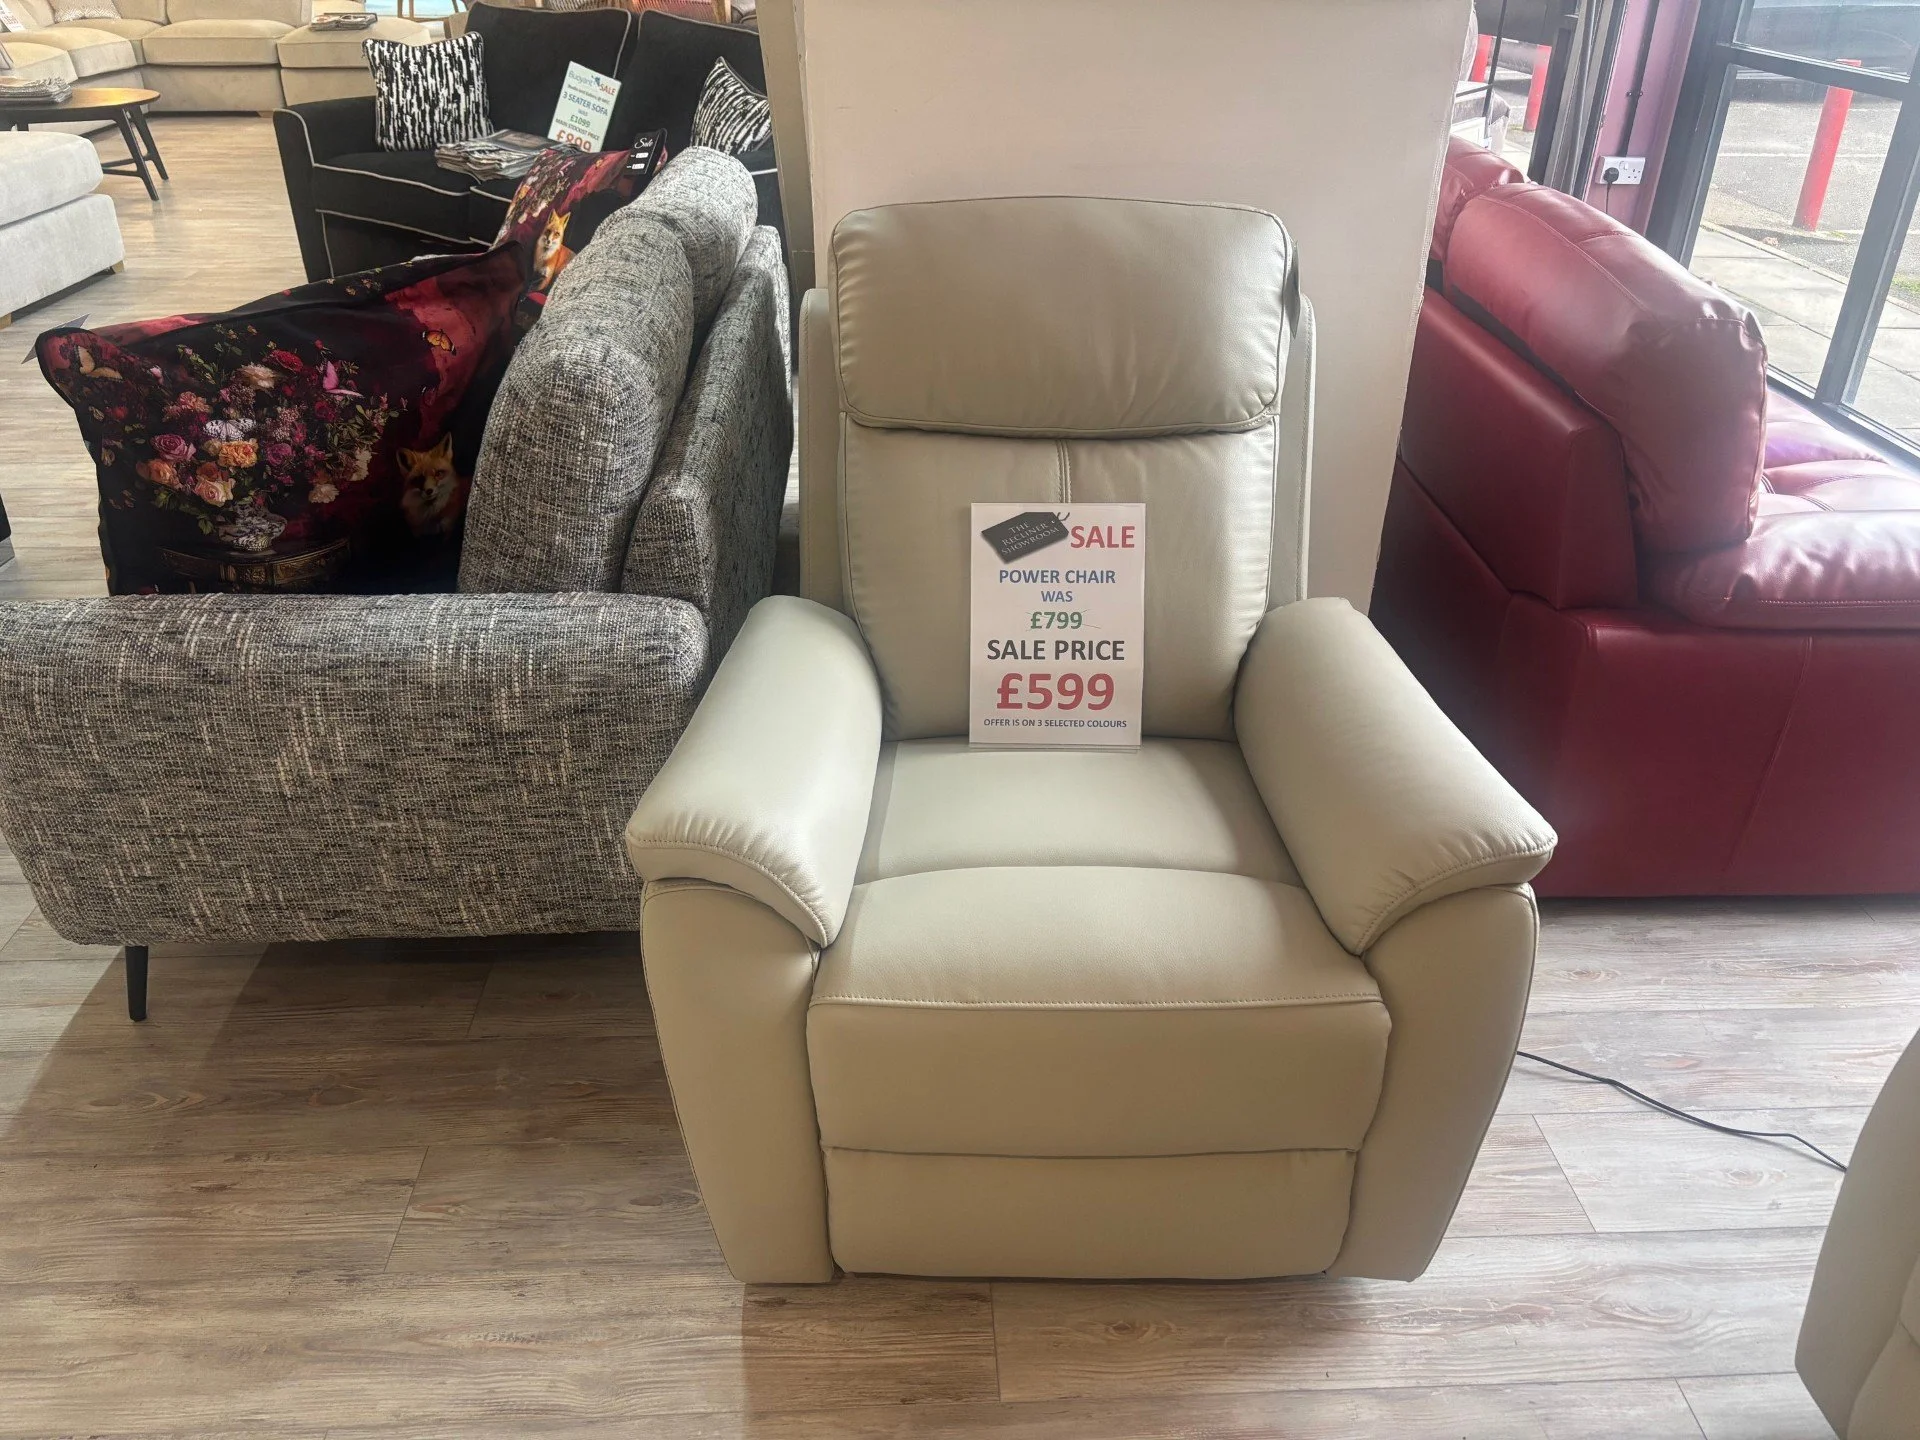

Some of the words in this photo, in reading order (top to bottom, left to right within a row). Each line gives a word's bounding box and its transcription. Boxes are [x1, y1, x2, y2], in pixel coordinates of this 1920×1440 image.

[600, 83, 616, 96] SALE
[562, 91, 568, 99] 3
[568, 93, 591, 109] SEATER
[592, 102, 608, 117] SOFA
[570, 114, 591, 128] £1099
[1001, 522, 1049, 547] RECLINER
[1008, 521, 1030, 534] THE
[1070, 525, 1136, 549] SALE
[1001, 527, 1060, 555] SHOWROOM
[999, 569, 1060, 584] POWER
[1065, 569, 1116, 584] CHAIR
[1041, 590, 1073, 603] WAS
[1030, 611, 1083, 630] £799
[987, 639, 1046, 660] SALE
[1054, 640, 1125, 661] PRICE
[996, 672, 1115, 711] £599
[983, 718, 1010, 727] OFFER
[1012, 718, 1020, 727] IS
[1022, 718, 1036, 727] ON
[1037, 719, 1043, 727] 3
[1044, 719, 1085, 728] SELECTED
[1086, 719, 1127, 728] COLOURS
